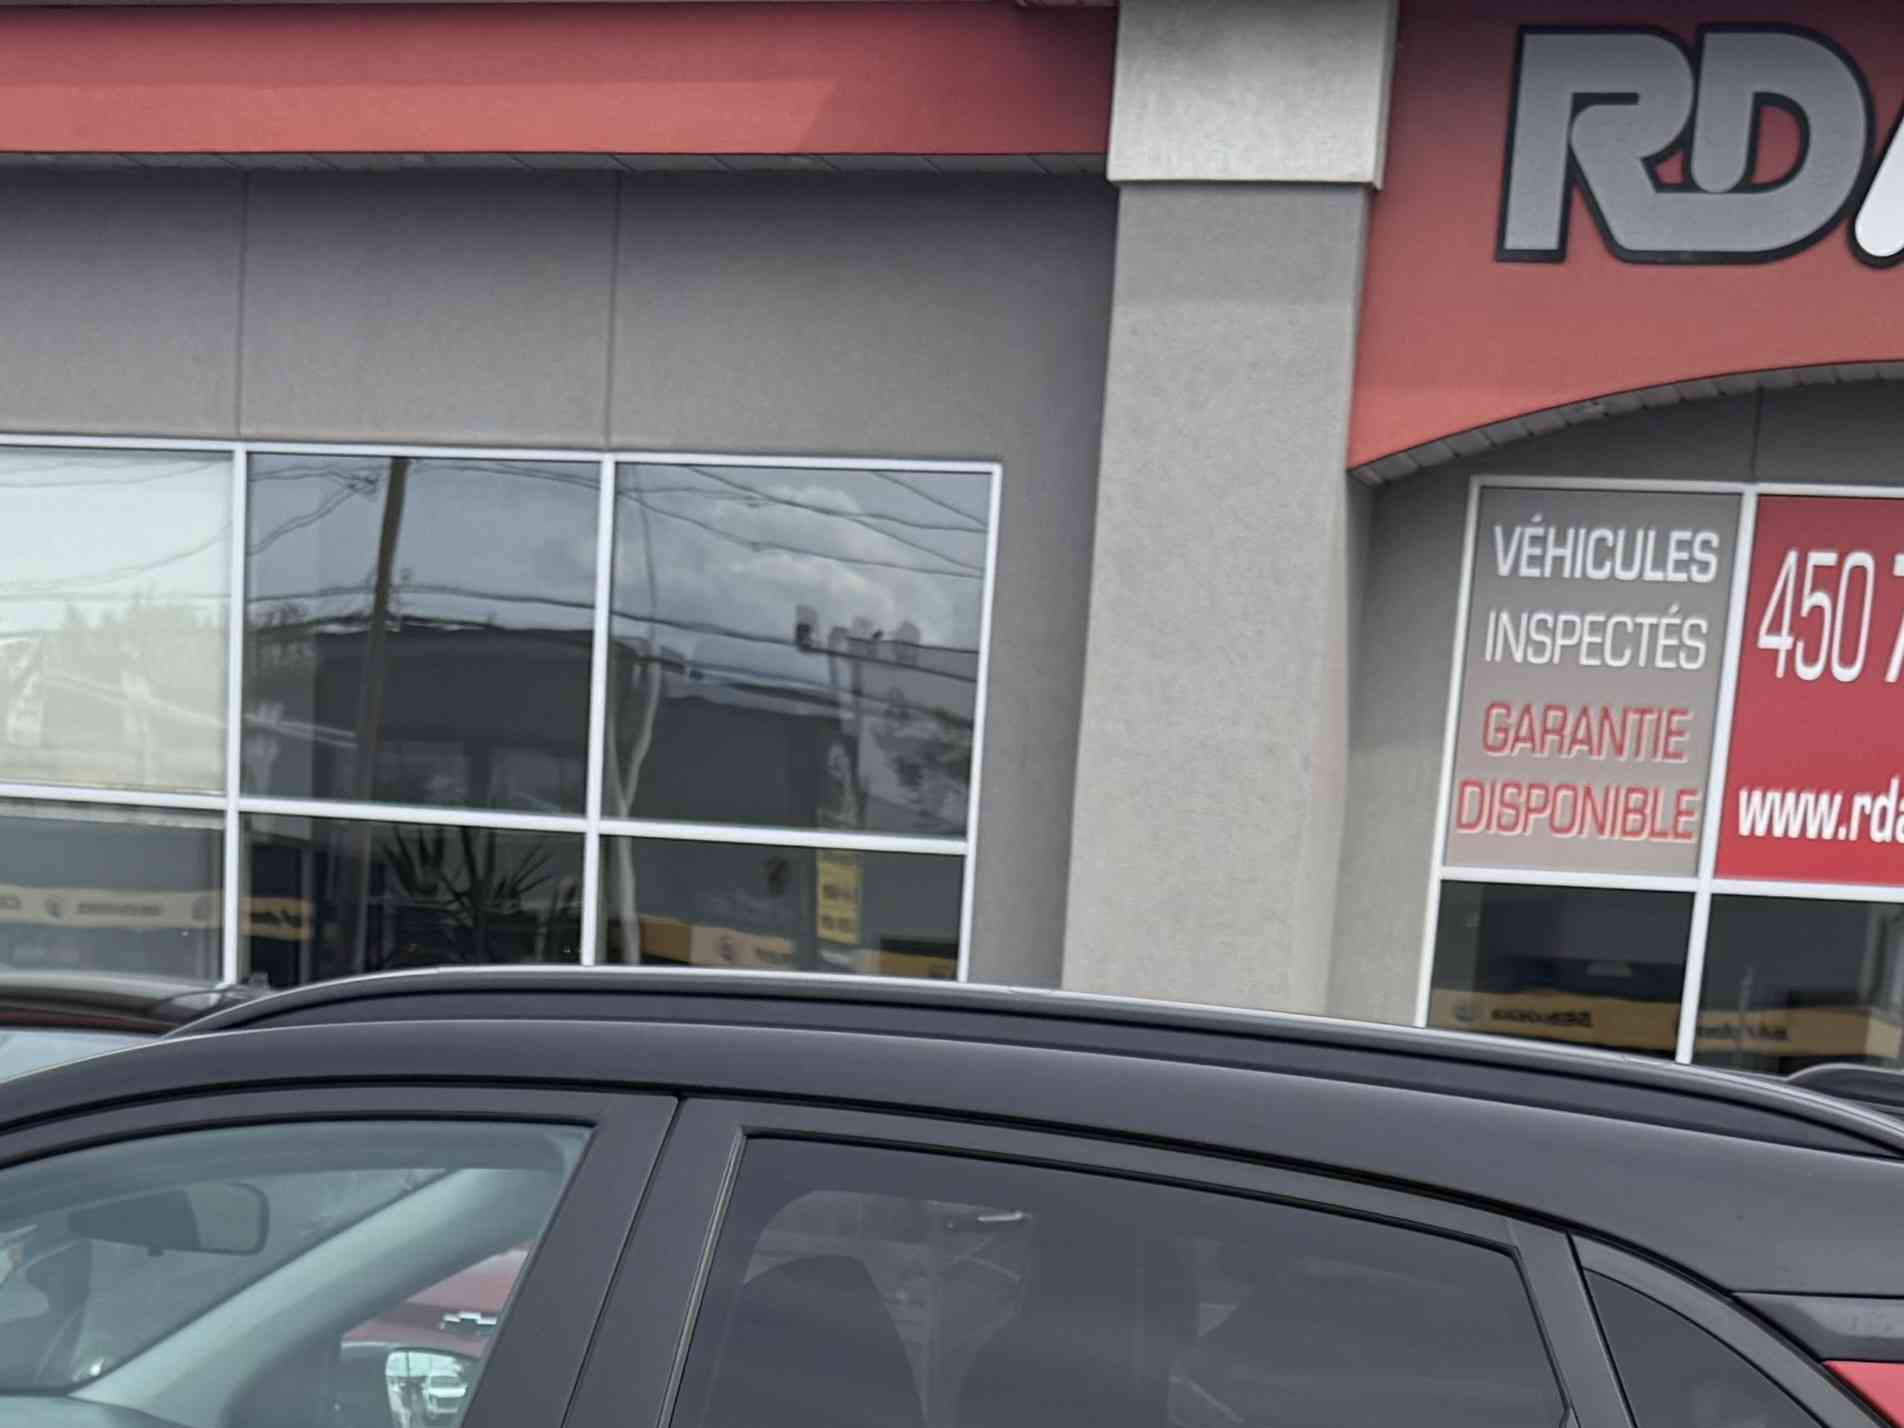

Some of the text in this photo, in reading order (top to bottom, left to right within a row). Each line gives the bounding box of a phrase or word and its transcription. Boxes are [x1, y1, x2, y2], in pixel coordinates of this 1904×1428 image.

[1493, 513, 1721, 584] VÉHICULES
[1484, 603, 1709, 670] INSPECTÉS
[1757, 549, 1877, 683] 450
[1481, 701, 1694, 764] GARANTIE
[1456, 778, 1702, 843] DISPONIBLE
